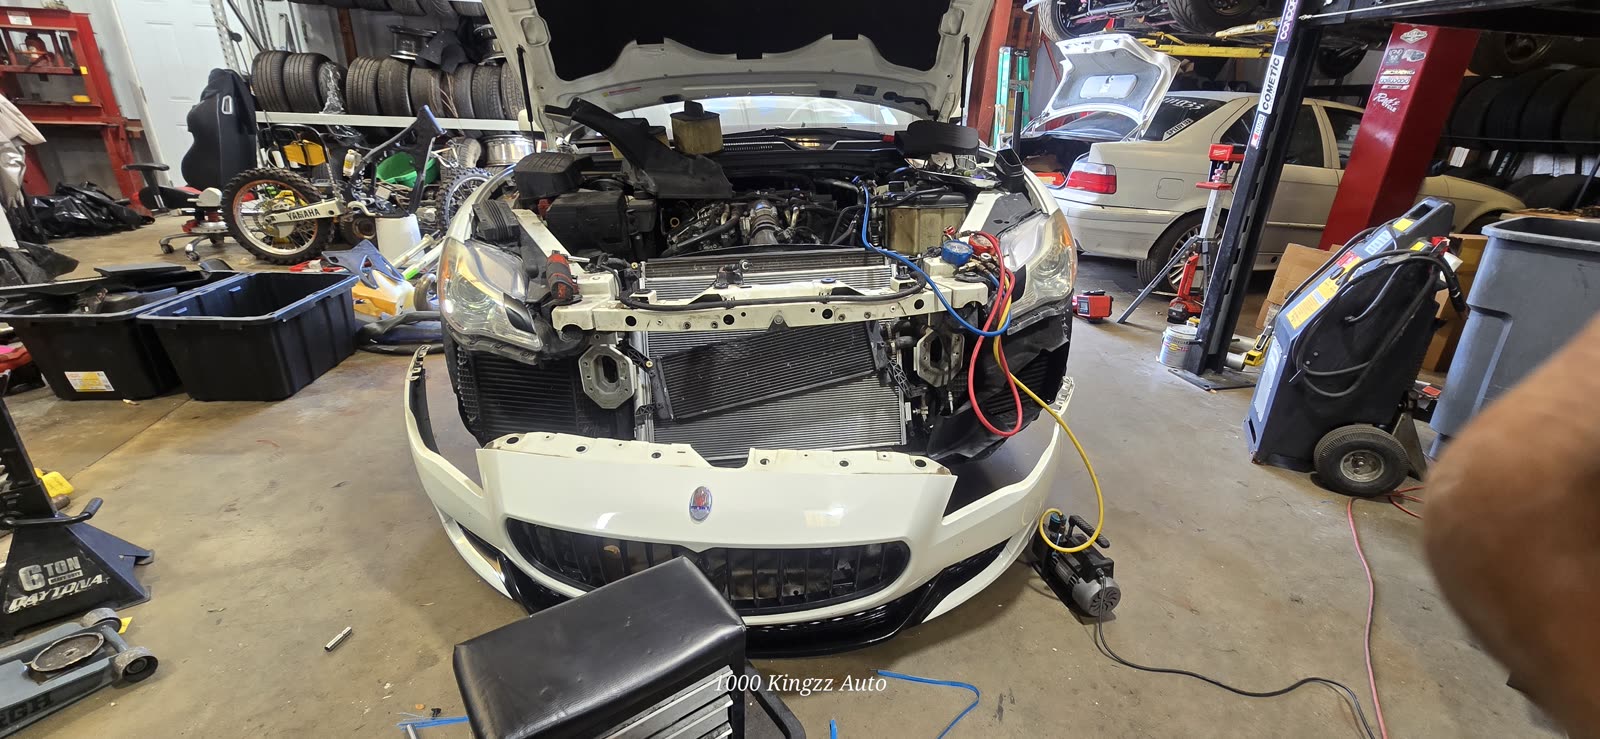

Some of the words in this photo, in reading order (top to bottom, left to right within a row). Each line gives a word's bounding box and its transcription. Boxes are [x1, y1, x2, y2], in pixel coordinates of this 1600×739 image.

[286, 208, 320, 220] YAMAHA
[19, 564, 45, 591] 6
[43, 556, 81, 576] TON
[8, 574, 103, 614] DAYTONA
